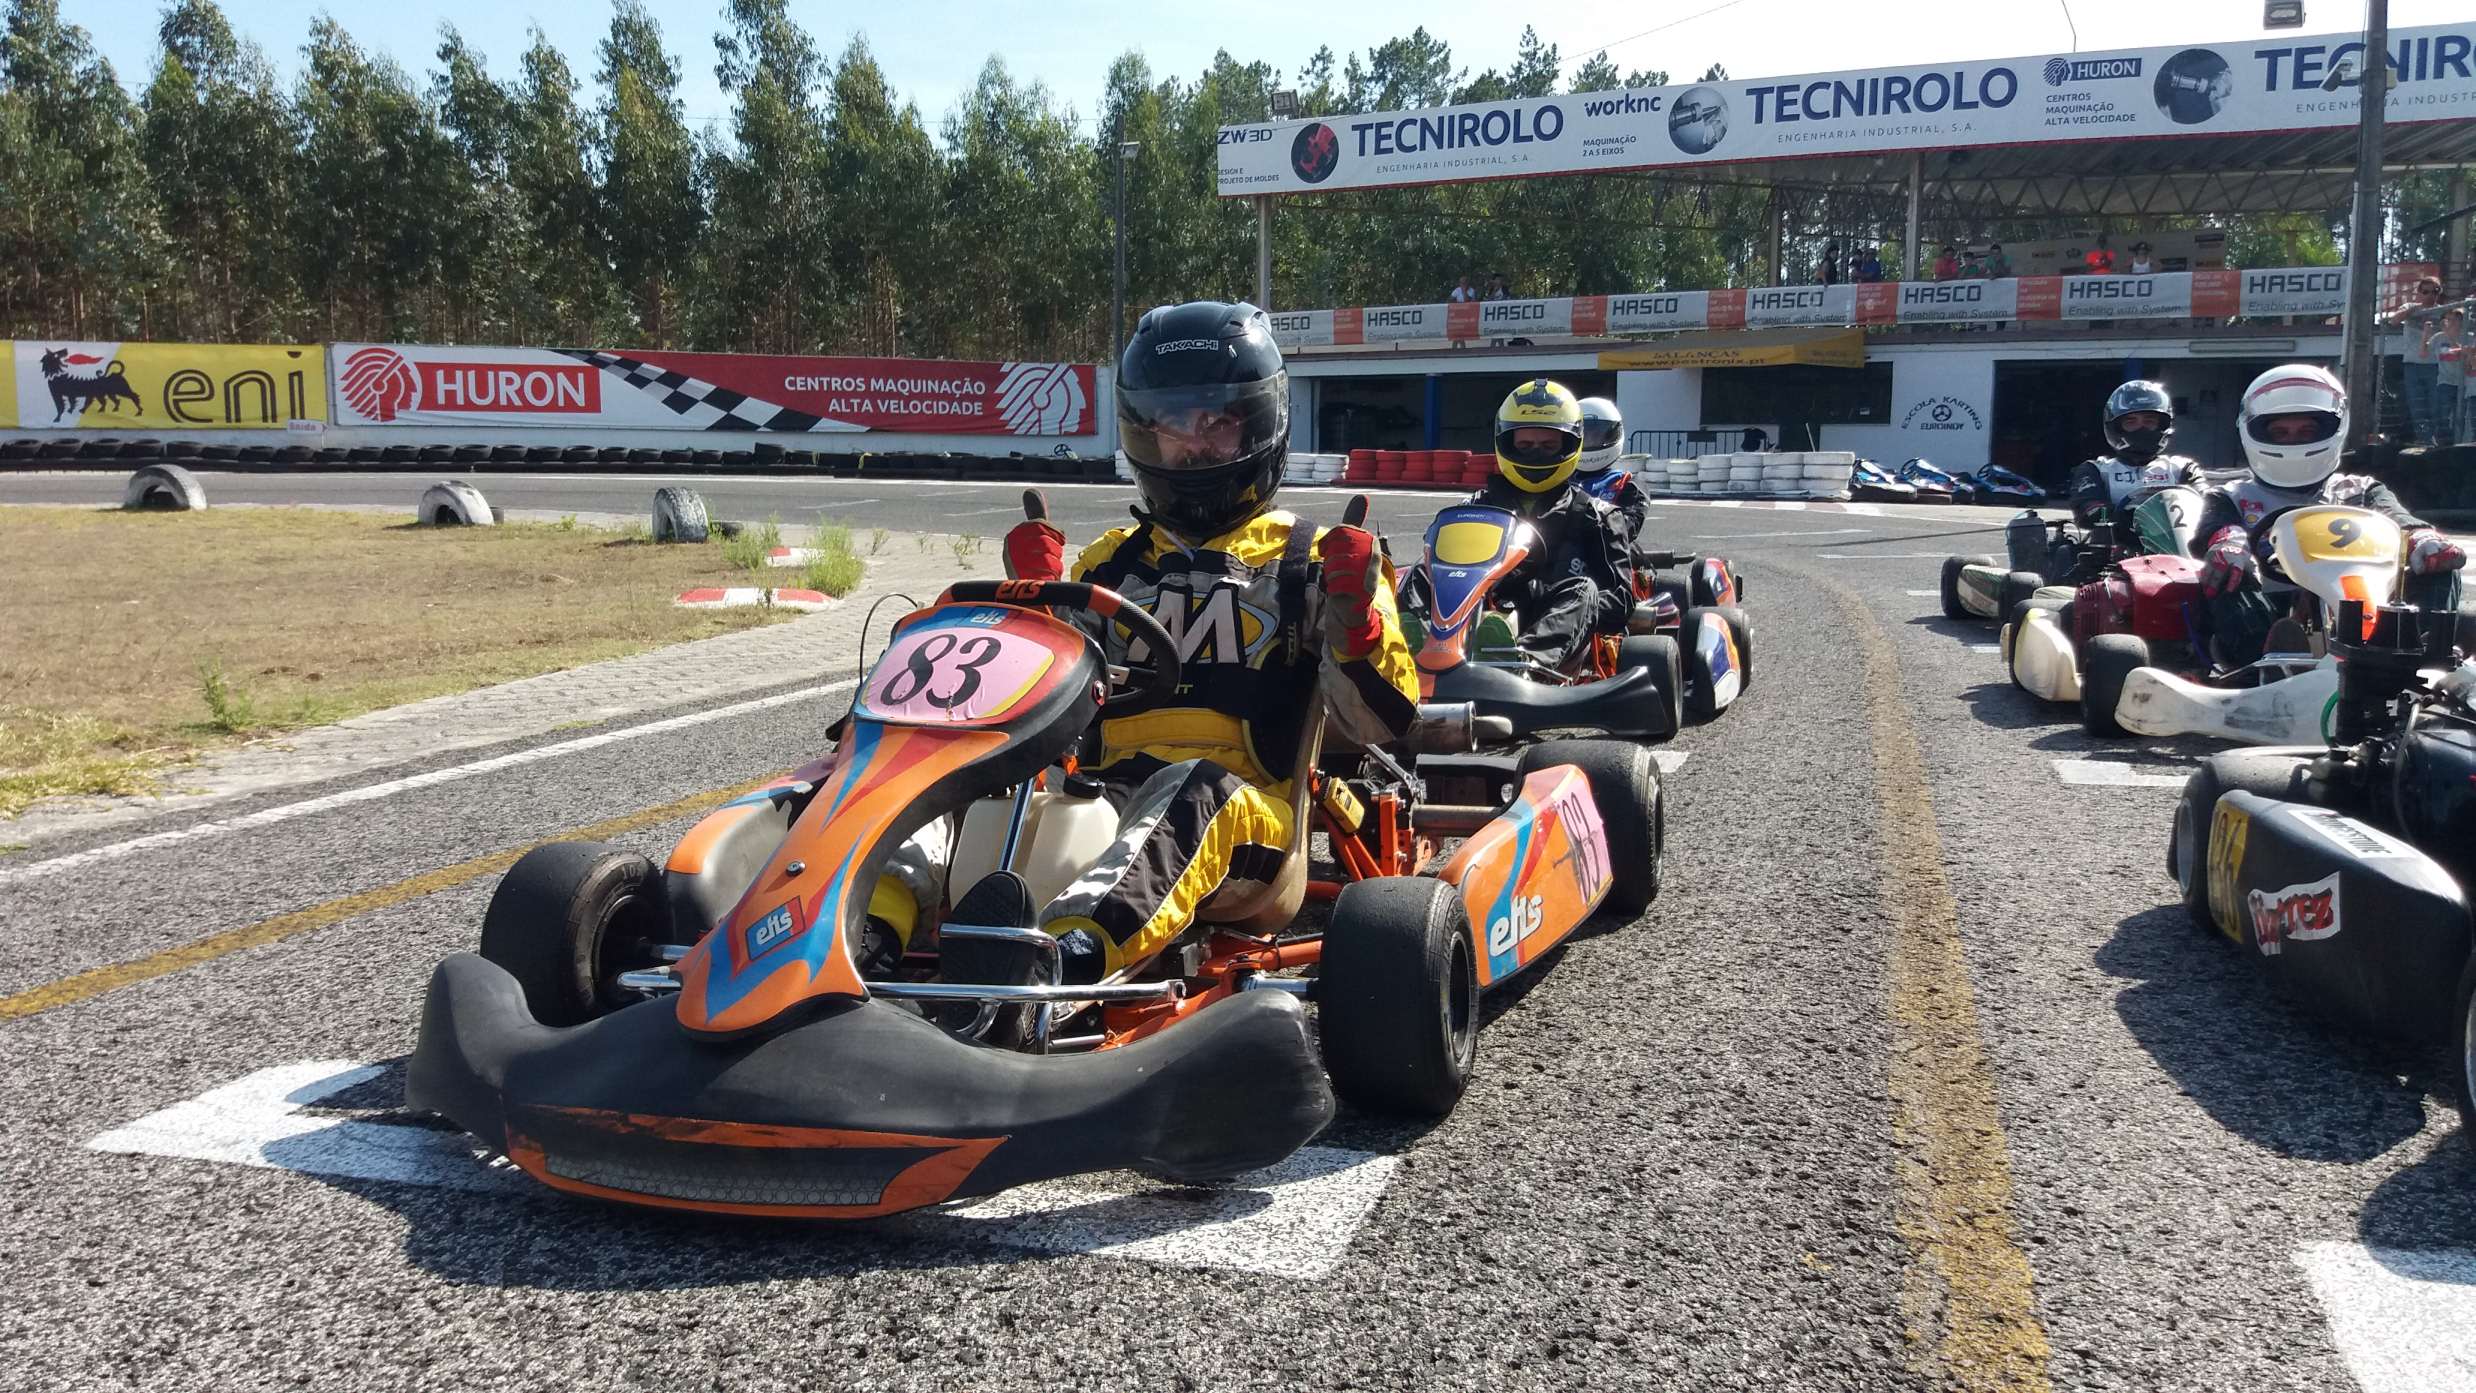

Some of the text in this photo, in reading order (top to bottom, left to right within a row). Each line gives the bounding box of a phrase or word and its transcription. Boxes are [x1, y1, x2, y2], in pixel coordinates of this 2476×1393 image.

[2077, 61, 2137, 78] HURON
[2254, 35, 2476, 91] TECNIR
[1584, 93, 1662, 117] worknc
[1746, 67, 2018, 125] TECNIROLO
[2045, 93, 2092, 103] CENTROS
[2296, 97, 2400, 113] ENGENHA
[2045, 102, 2114, 114] MAQUINAÇÃO
[2045, 113, 2137, 126] ALTA VELOCIDADE
[1351, 104, 1564, 157] TECNIROLO
[1777, 130, 1857, 144] ENGENHARIA
[1583, 135, 1637, 147] MAQUINAÇÃO
[1601, 146, 1625, 156] EIXOS
[1376, 161, 1439, 174] ENGENHARIA
[1253, 174, 1280, 183] MOLDES
[2068, 280, 2153, 299] HASCO
[2249, 273, 2342, 294] HASCO
[1752, 291, 1824, 309] HASCO
[1904, 285, 1982, 304] HASCO
[1484, 304, 1545, 322] HASCO
[1612, 298, 1679, 316] HASCO
[1271, 316, 1311, 331] ASCO
[1368, 310, 1422, 327] HASCO
[1155, 339, 1219, 356] TAKACHI
[163, 350, 305, 424] eni
[436, 370, 586, 407] HURON
[784, 375, 987, 399] CENTROS MAQUINAÇÃO
[828, 398, 984, 416] ALTA VELOCIDADE
[1901, 395, 1983, 431] ESCOLA KARTING
[2169, 504, 2188, 528] 2
[2328, 518, 2362, 549] 9
[879, 633, 1002, 709] 83
